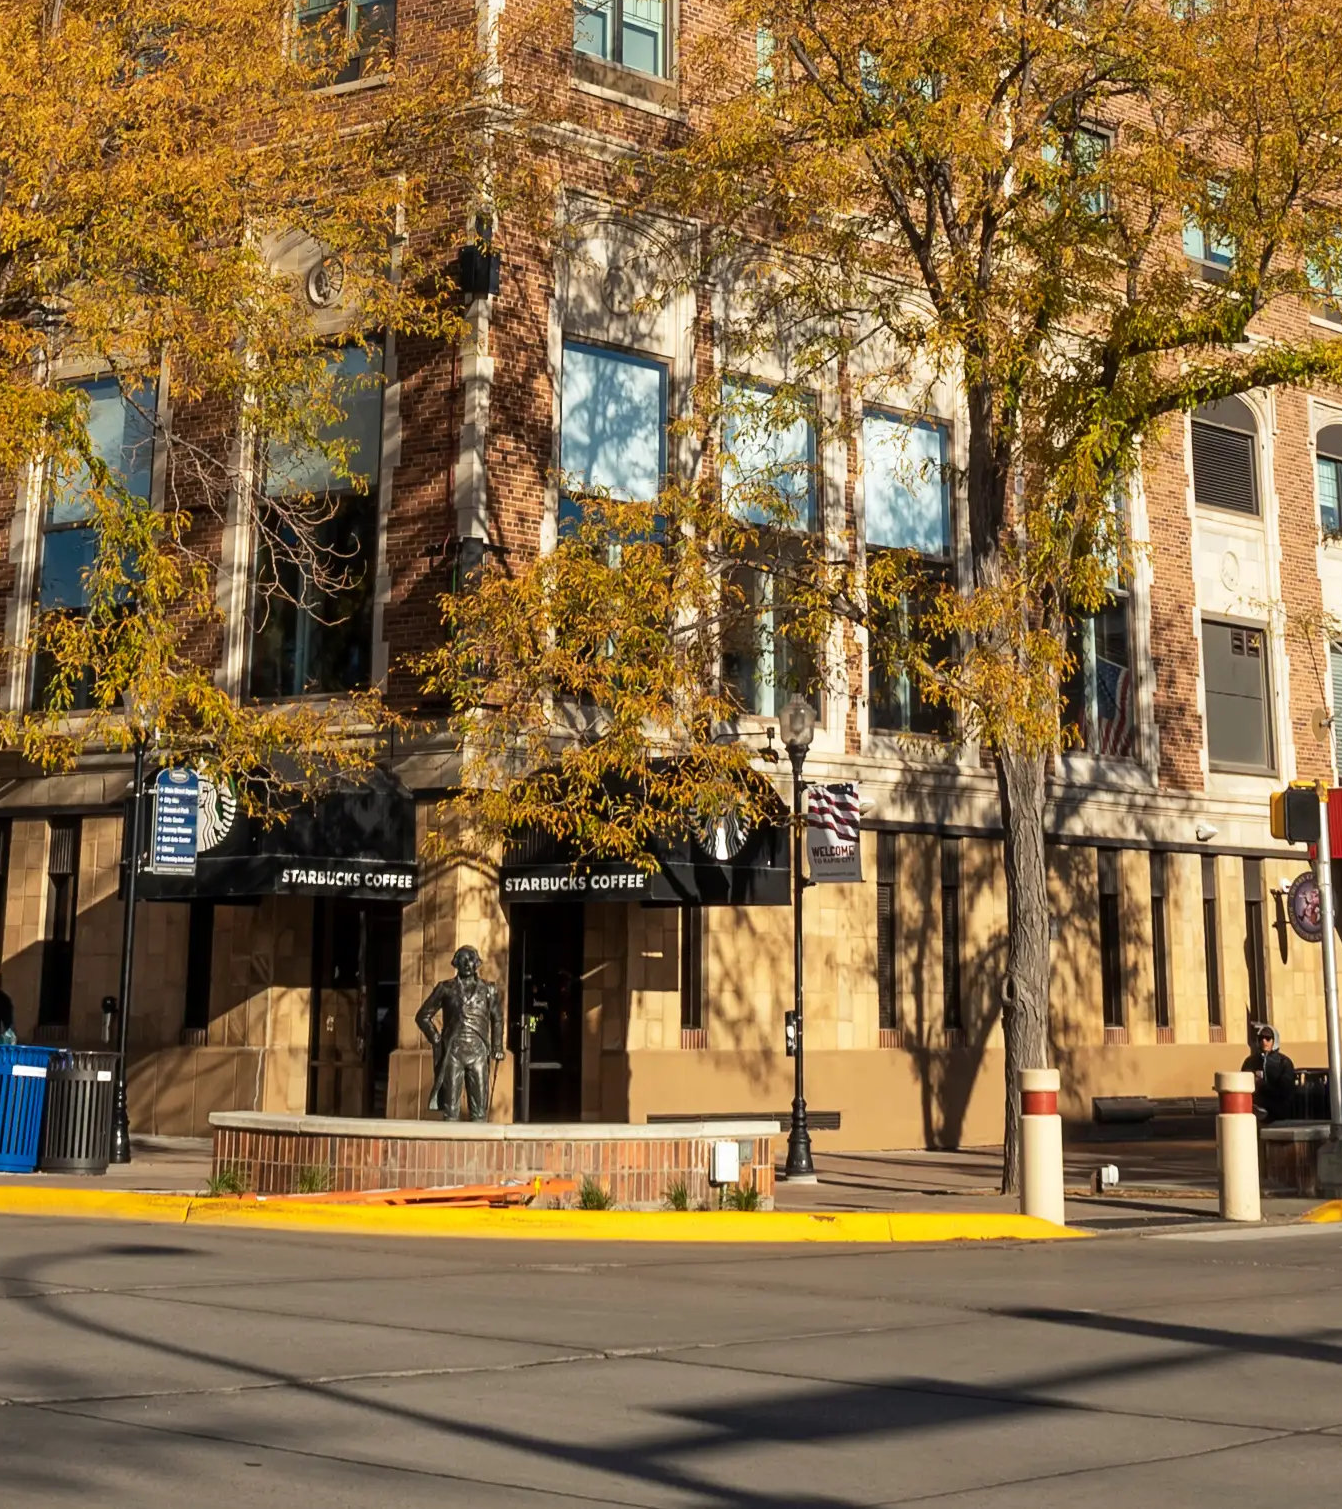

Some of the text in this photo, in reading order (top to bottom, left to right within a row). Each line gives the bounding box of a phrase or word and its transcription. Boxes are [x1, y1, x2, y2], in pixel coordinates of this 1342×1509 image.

[811, 845, 855, 857] WELCOME
[281, 869, 413, 888] STARBUCKS COFFEE
[505, 874, 645, 892] STARBUCKS COFFEE
